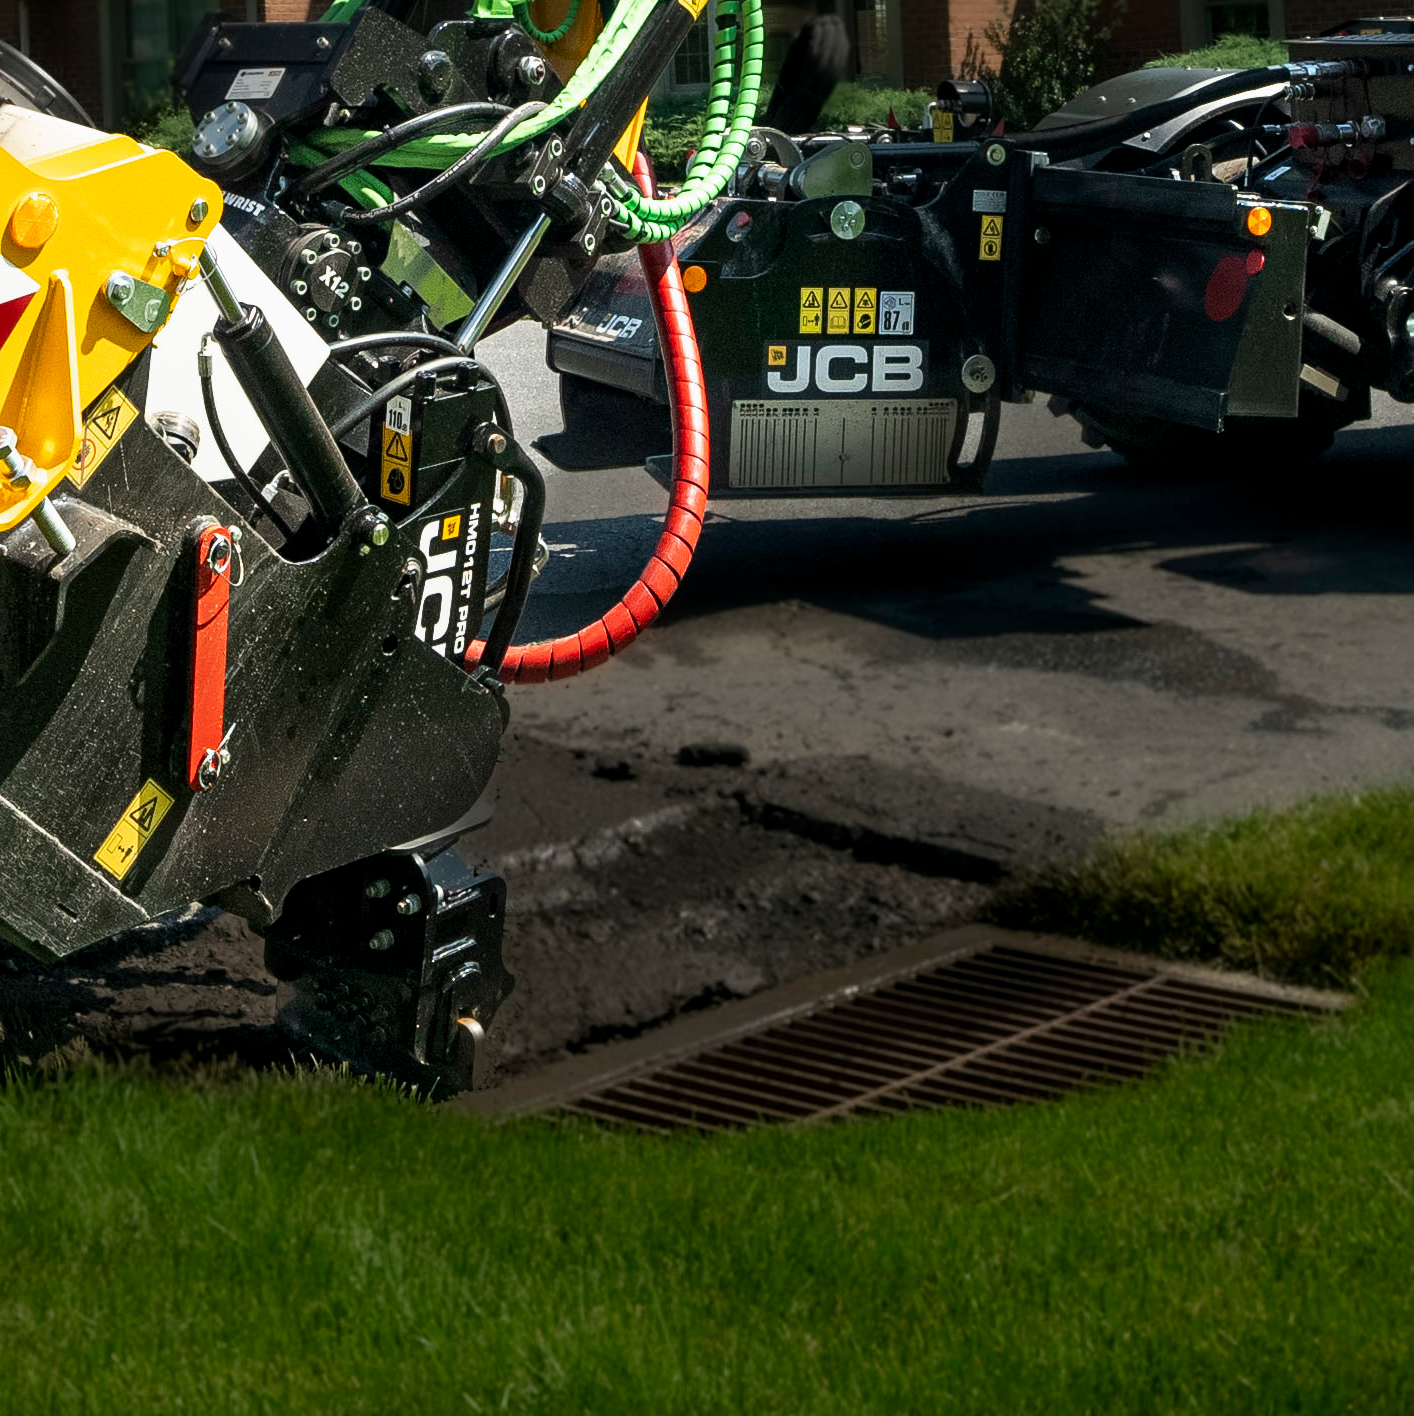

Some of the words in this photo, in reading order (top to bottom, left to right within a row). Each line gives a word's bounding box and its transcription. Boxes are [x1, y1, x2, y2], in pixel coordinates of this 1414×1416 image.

[222, 190, 266, 217] WRIST
[319, 265, 350, 300] X12
[884, 310, 900, 331] 87
[767, 344, 924, 393] JCB
[388, 408, 403, 430] 110
[414, 519, 458, 658] JC
[453, 604, 469, 655] PRO
